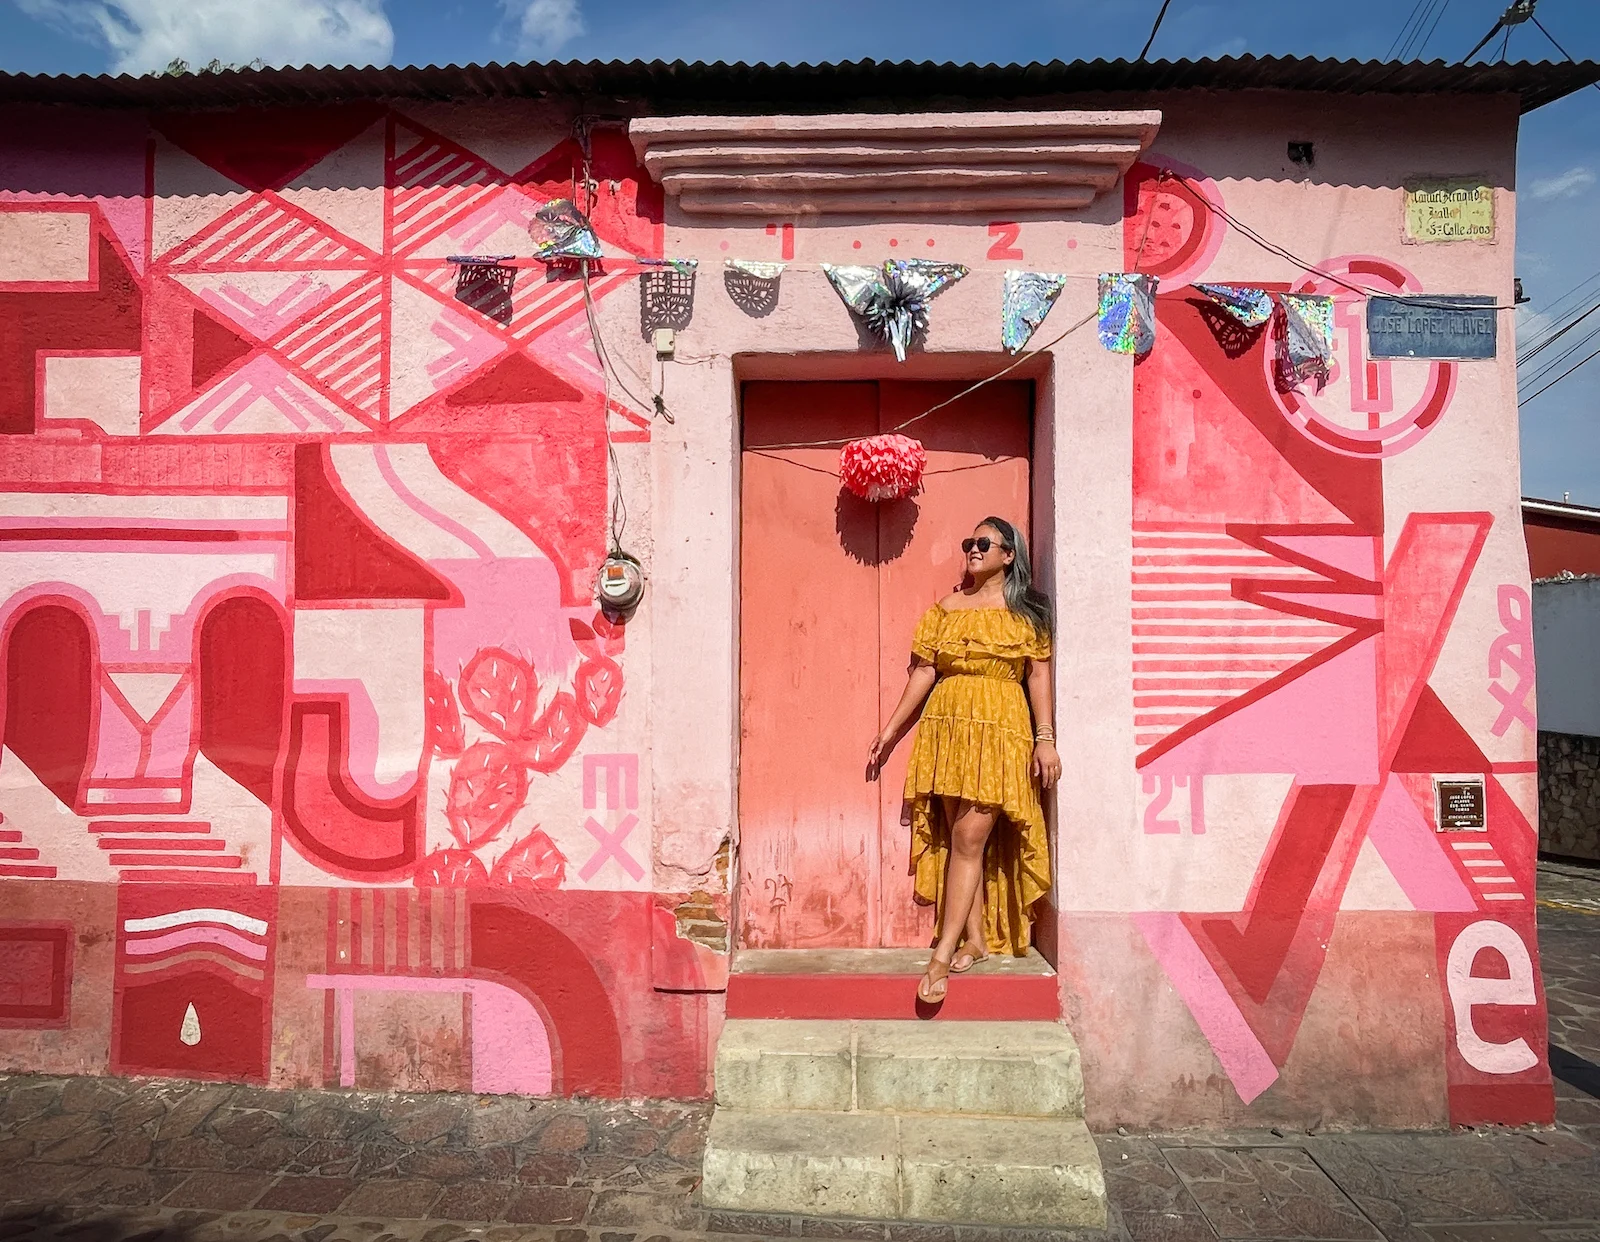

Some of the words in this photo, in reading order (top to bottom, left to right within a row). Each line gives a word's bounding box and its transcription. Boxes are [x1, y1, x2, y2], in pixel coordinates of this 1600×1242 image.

[1443, 222, 1465, 235] Calle
[987, 221, 1023, 260] 2
[1407, 316, 1443, 334] LOPEZ
